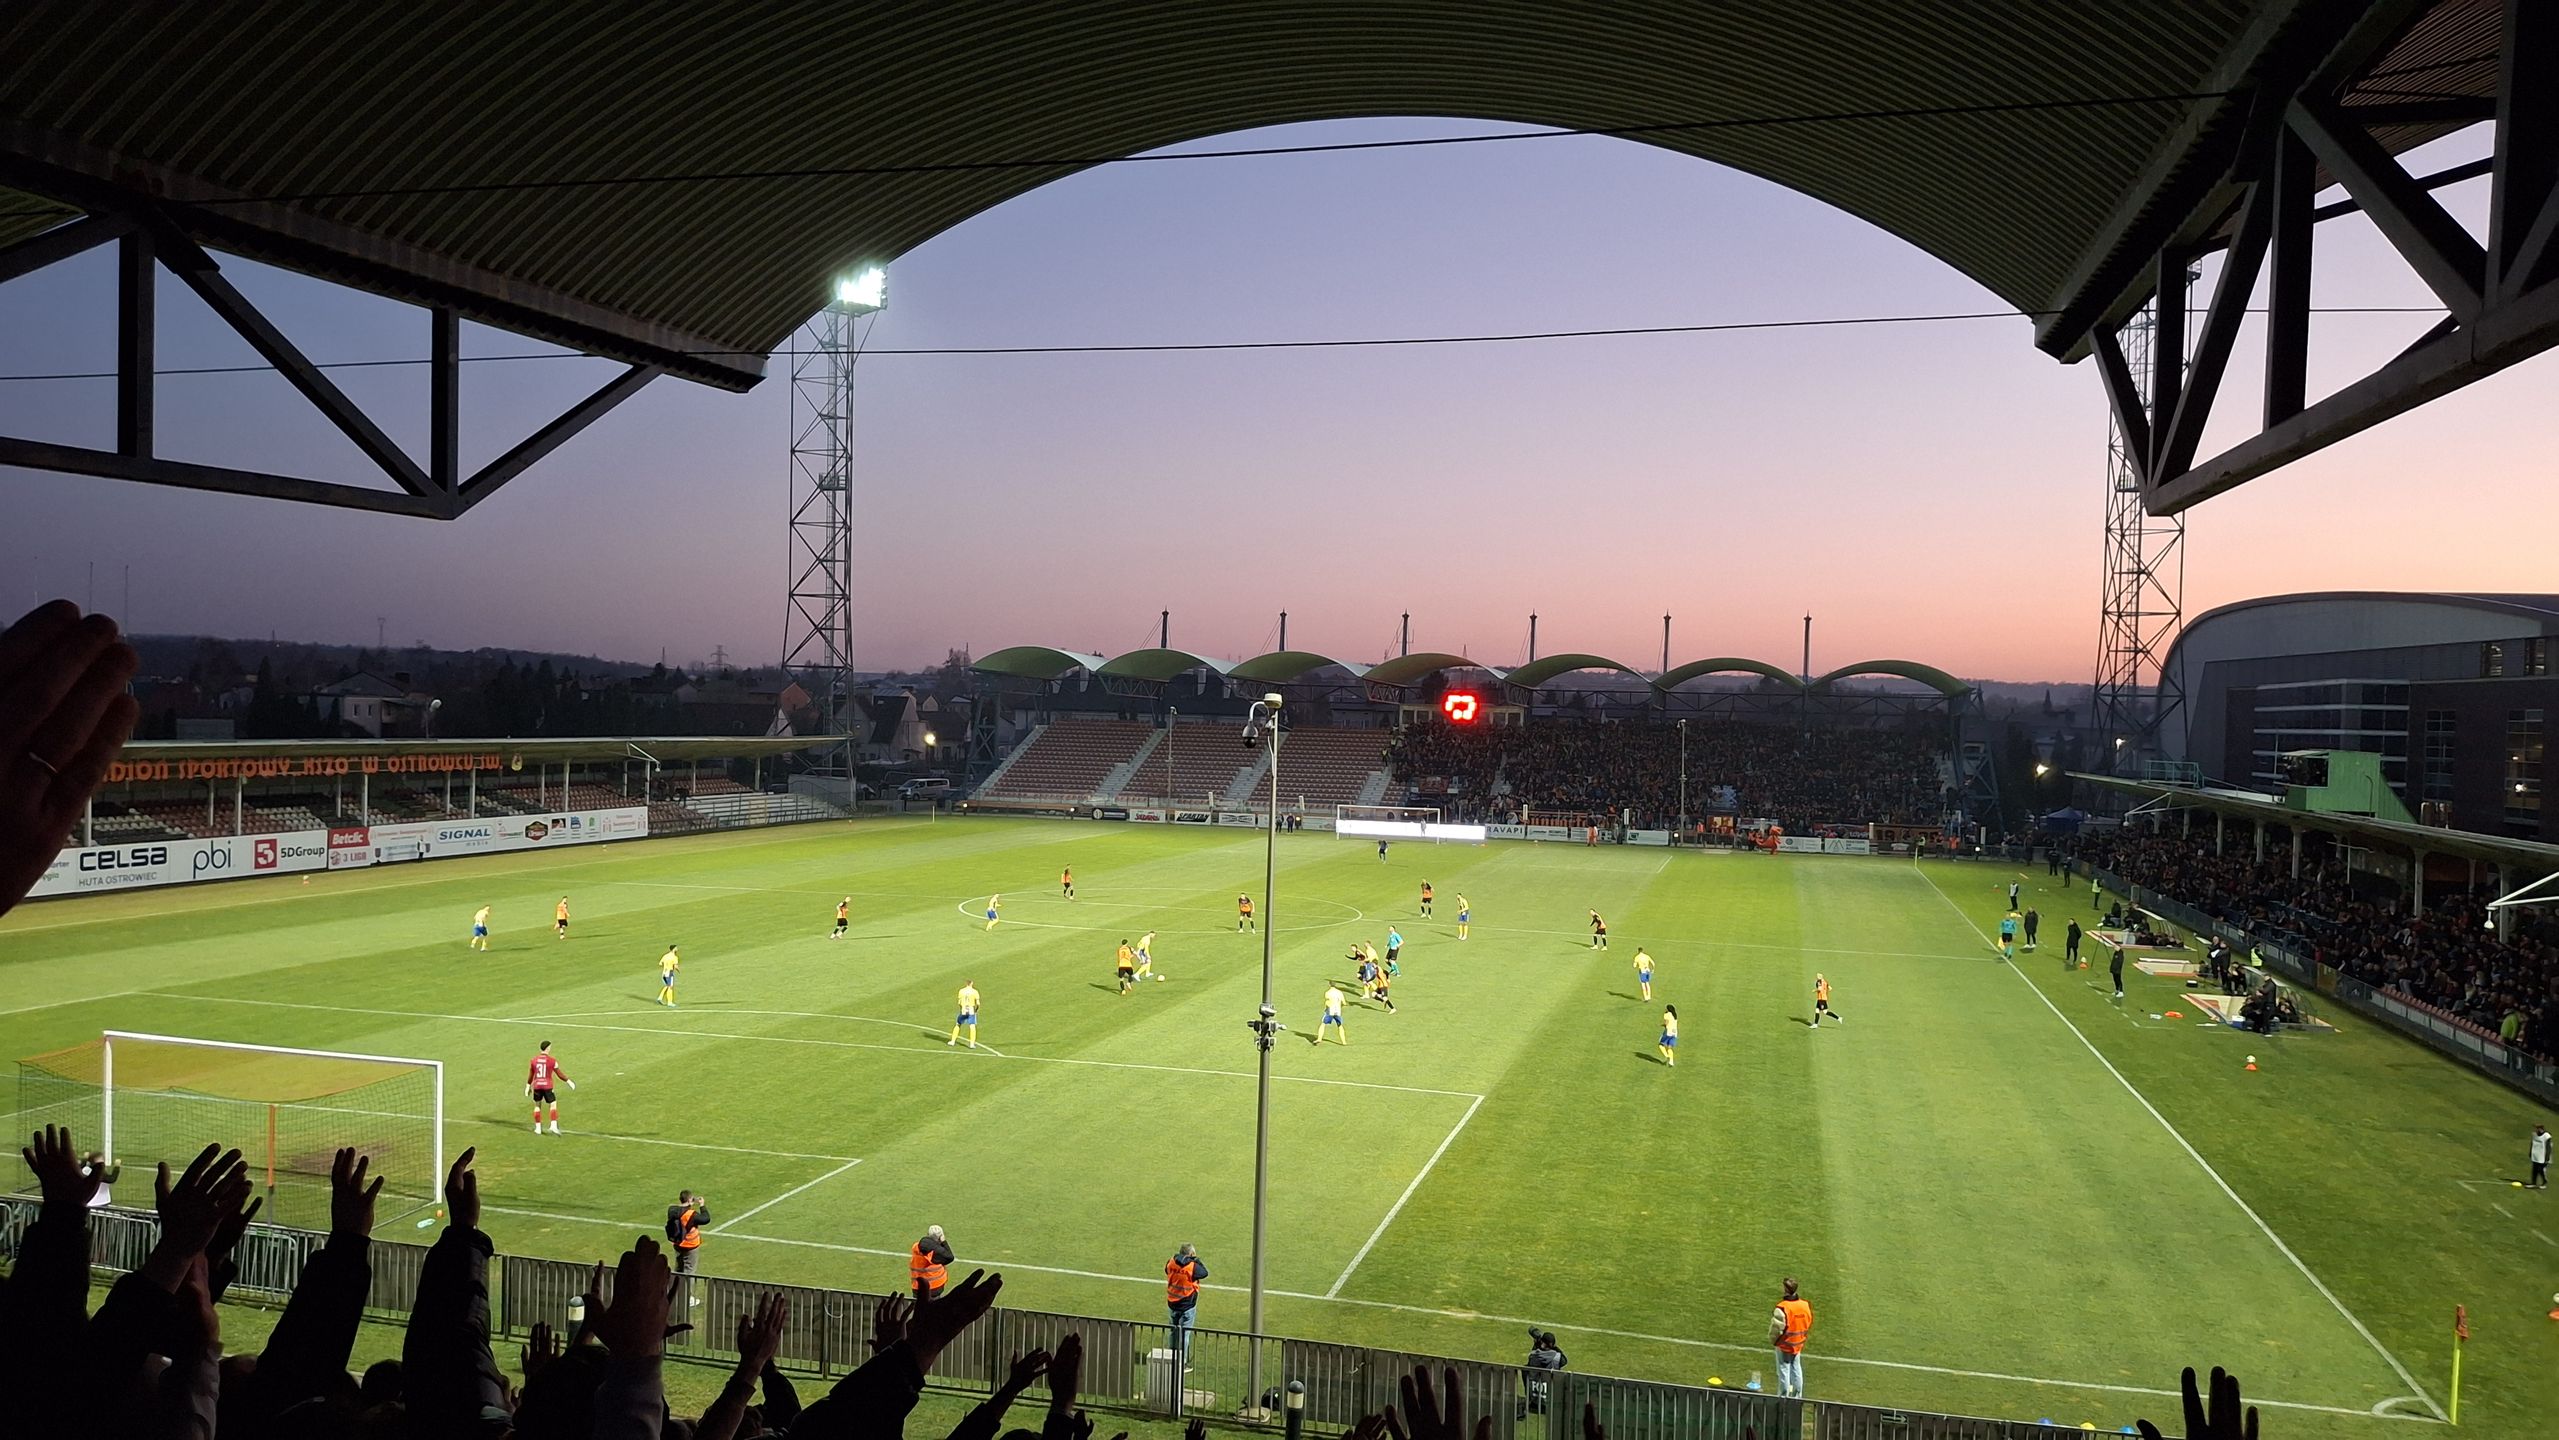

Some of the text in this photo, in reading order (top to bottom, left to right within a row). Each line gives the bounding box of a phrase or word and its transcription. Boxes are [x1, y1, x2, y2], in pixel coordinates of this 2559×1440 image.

[103, 760, 168, 782] DION
[332, 831, 363, 845] Betclic
[439, 828, 490, 841] SIGNAL
[193, 840, 231, 880] pbi
[280, 846, 325, 859] 5DGroup
[79, 871, 158, 887] HUTA OSTROWIEC
[535, 1063, 547, 1078] 31
